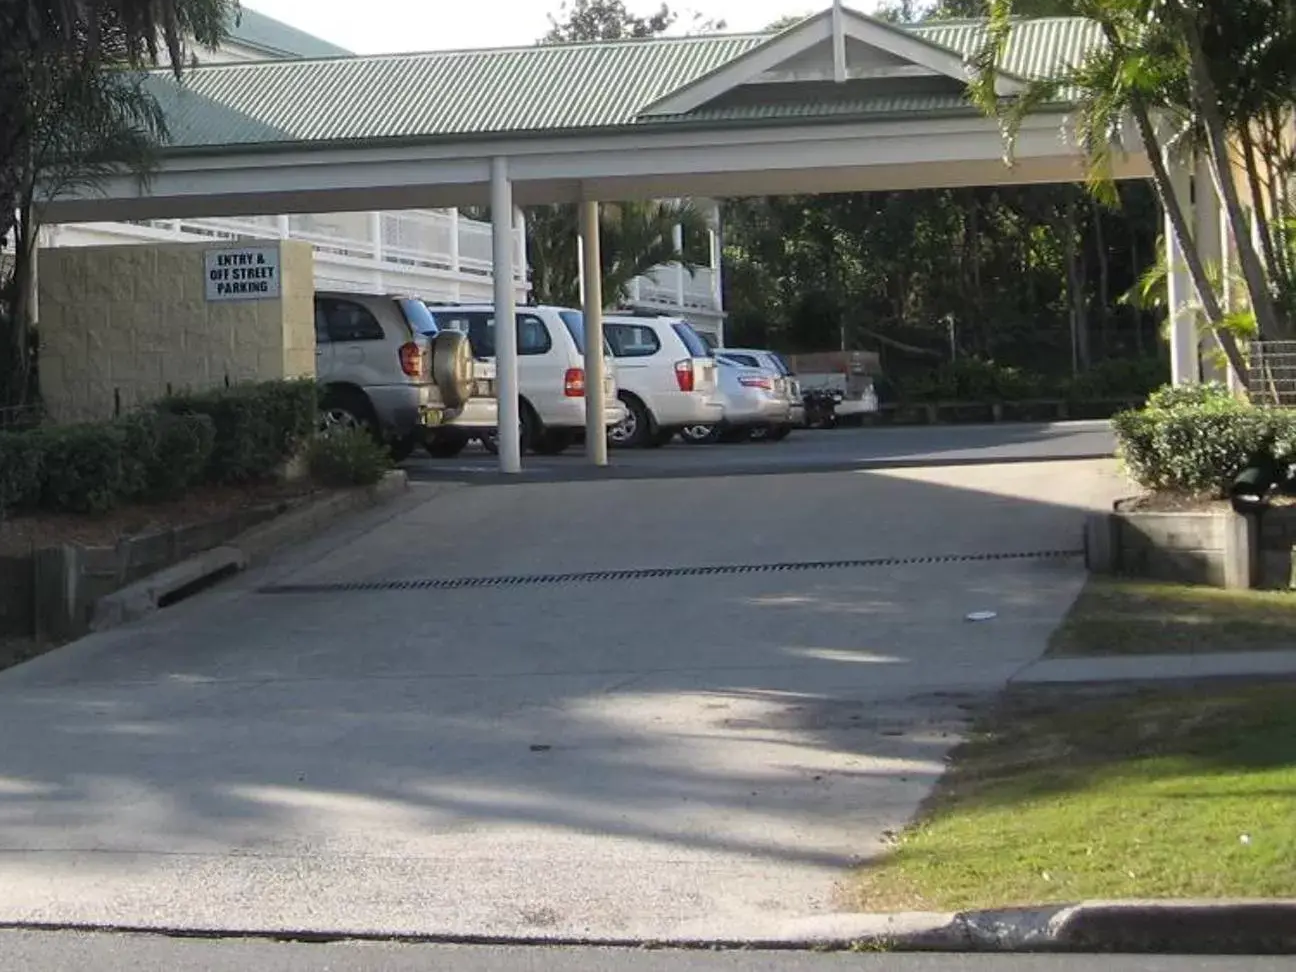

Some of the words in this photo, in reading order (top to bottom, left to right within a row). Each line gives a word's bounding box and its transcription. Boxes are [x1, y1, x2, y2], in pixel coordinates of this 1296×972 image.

[217, 253, 253, 266] ENTRY
[256, 253, 265, 265] &
[210, 269, 229, 281] OFF
[232, 266, 275, 280] STREET
[217, 281, 269, 296] PARKING
